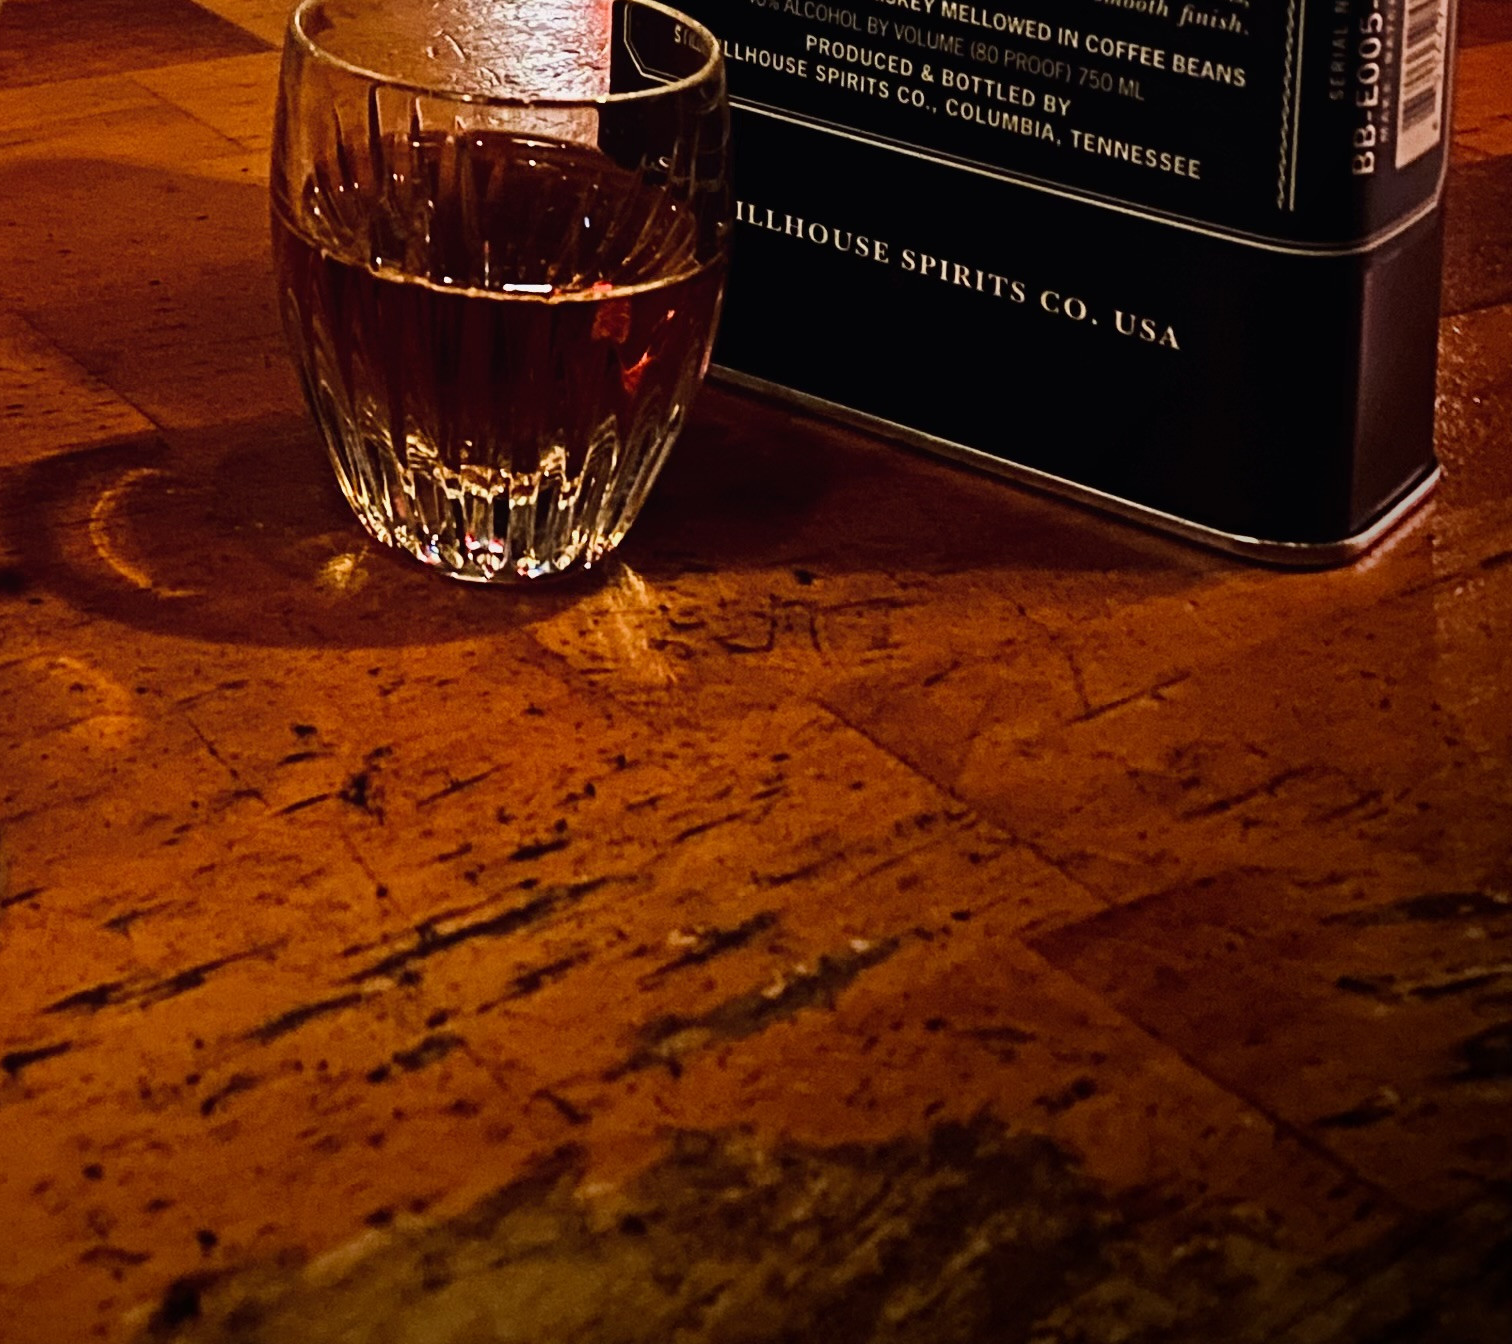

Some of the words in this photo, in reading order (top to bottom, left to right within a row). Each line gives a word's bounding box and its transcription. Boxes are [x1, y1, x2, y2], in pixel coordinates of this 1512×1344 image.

[867, 15, 889, 38] BY
[894, 21, 965, 56] VOLUME
[970, 40, 999, 65] (80
[1003, 49, 1072, 83] PROOF)
[1079, 66, 1114, 92] 750
[1118, 76, 1145, 101] ML
[1058, 26, 1079, 49] IN
[1085, 34, 1166, 70] COFFEE
[1172, 52, 1247, 88] BEANS
[1176, 3, 1250, 37] finish.
[805, 34, 913, 77] PRODUCED
[921, 63, 935, 83] &
[942, 68, 1036, 108] BOTTLED
[1043, 93, 1072, 117] BY
[1329, 25, 1350, 101] SERIAL
[815, 64, 890, 99] SPIRITS
[896, 86, 937, 114] CO.,
[945, 98, 1062, 147] COLUMBIA,
[1070, 128, 1202, 181] TENNESSEE
[735, 199, 889, 265] ILLHOUSE
[900, 248, 1027, 305] SPIRITS
[1039, 289, 1100, 327] CO.
[1113, 309, 1182, 352] USA
